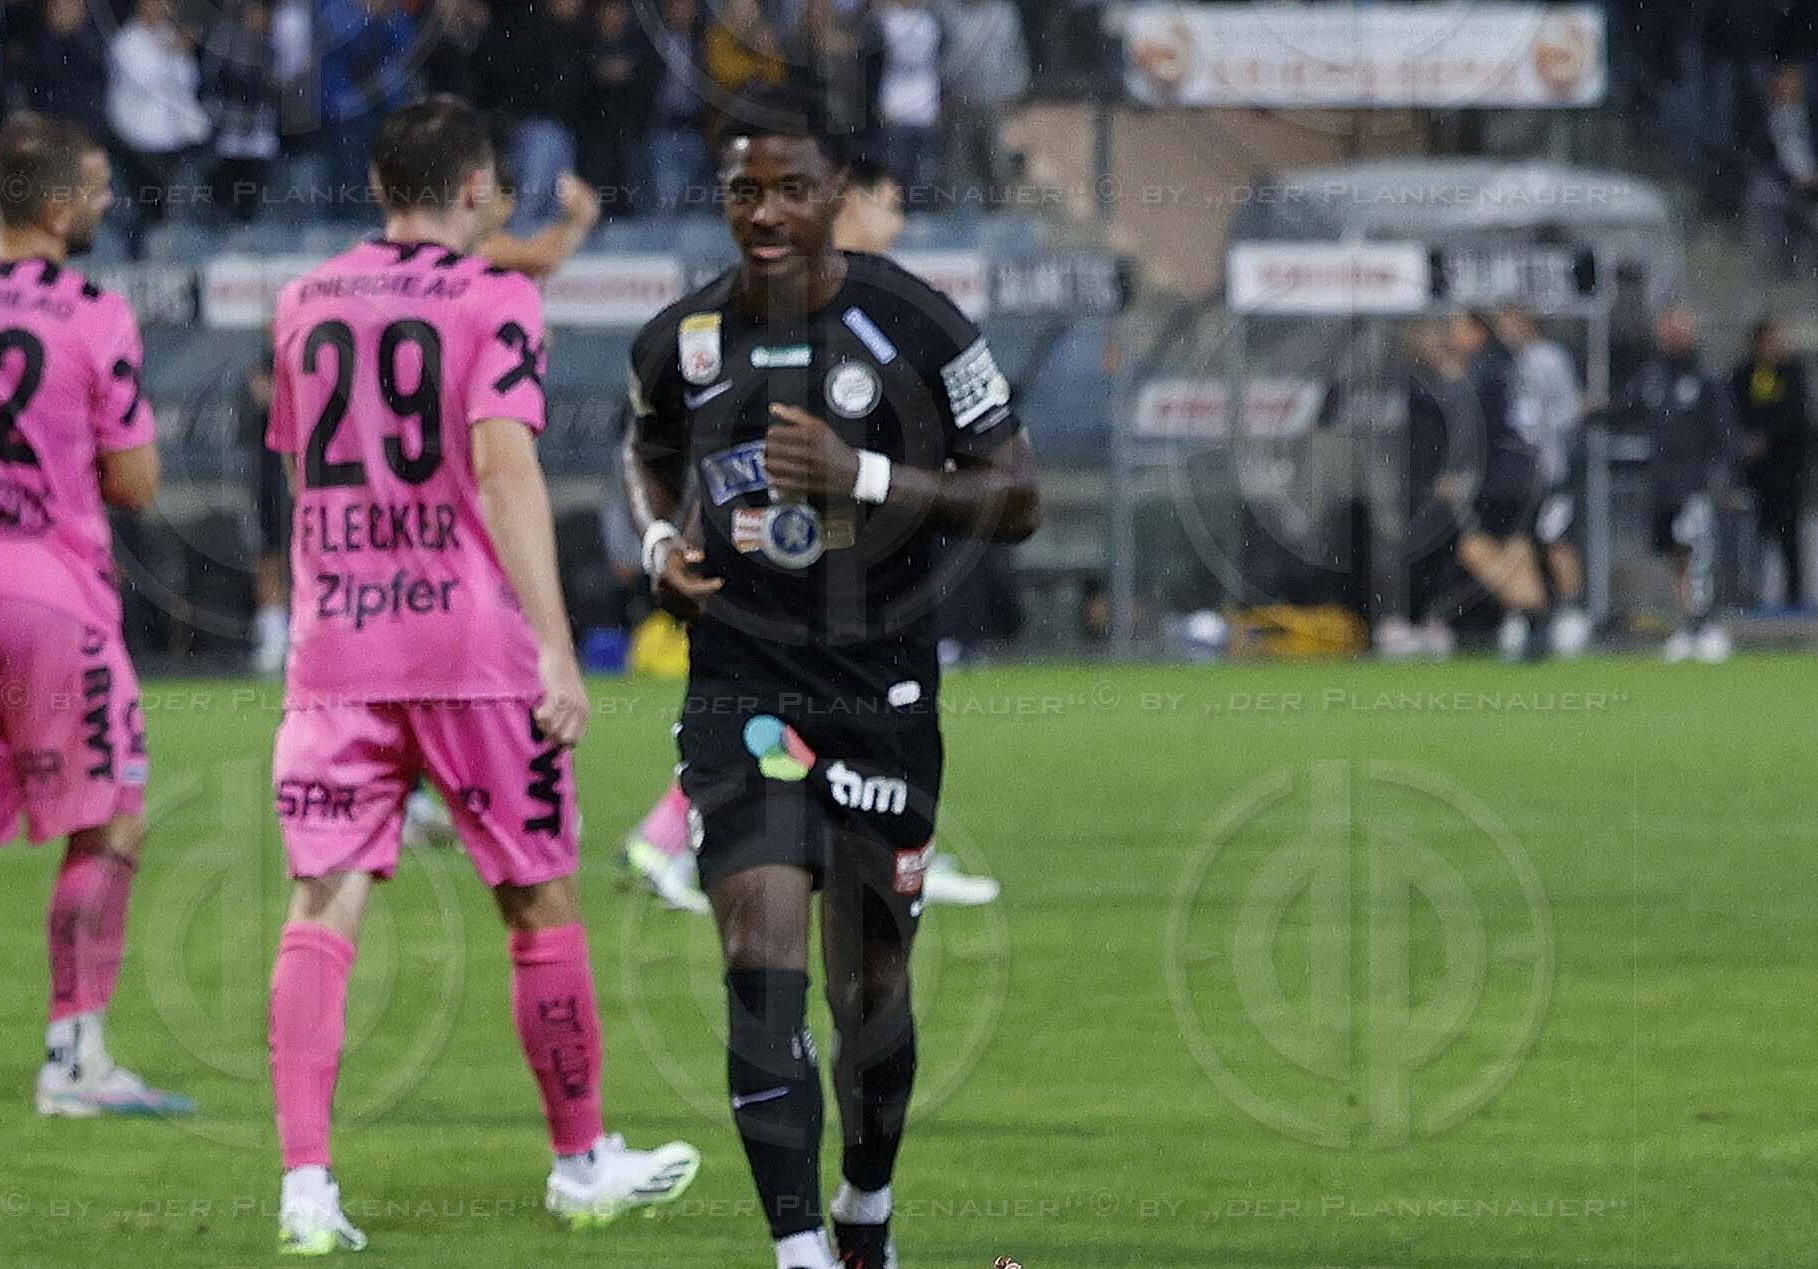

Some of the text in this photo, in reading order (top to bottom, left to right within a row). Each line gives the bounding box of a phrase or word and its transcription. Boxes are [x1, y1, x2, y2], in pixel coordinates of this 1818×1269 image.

[302, 318, 445, 488] 29
[302, 503, 461, 552] FLECKER
[316, 569, 460, 629] Zipfer
